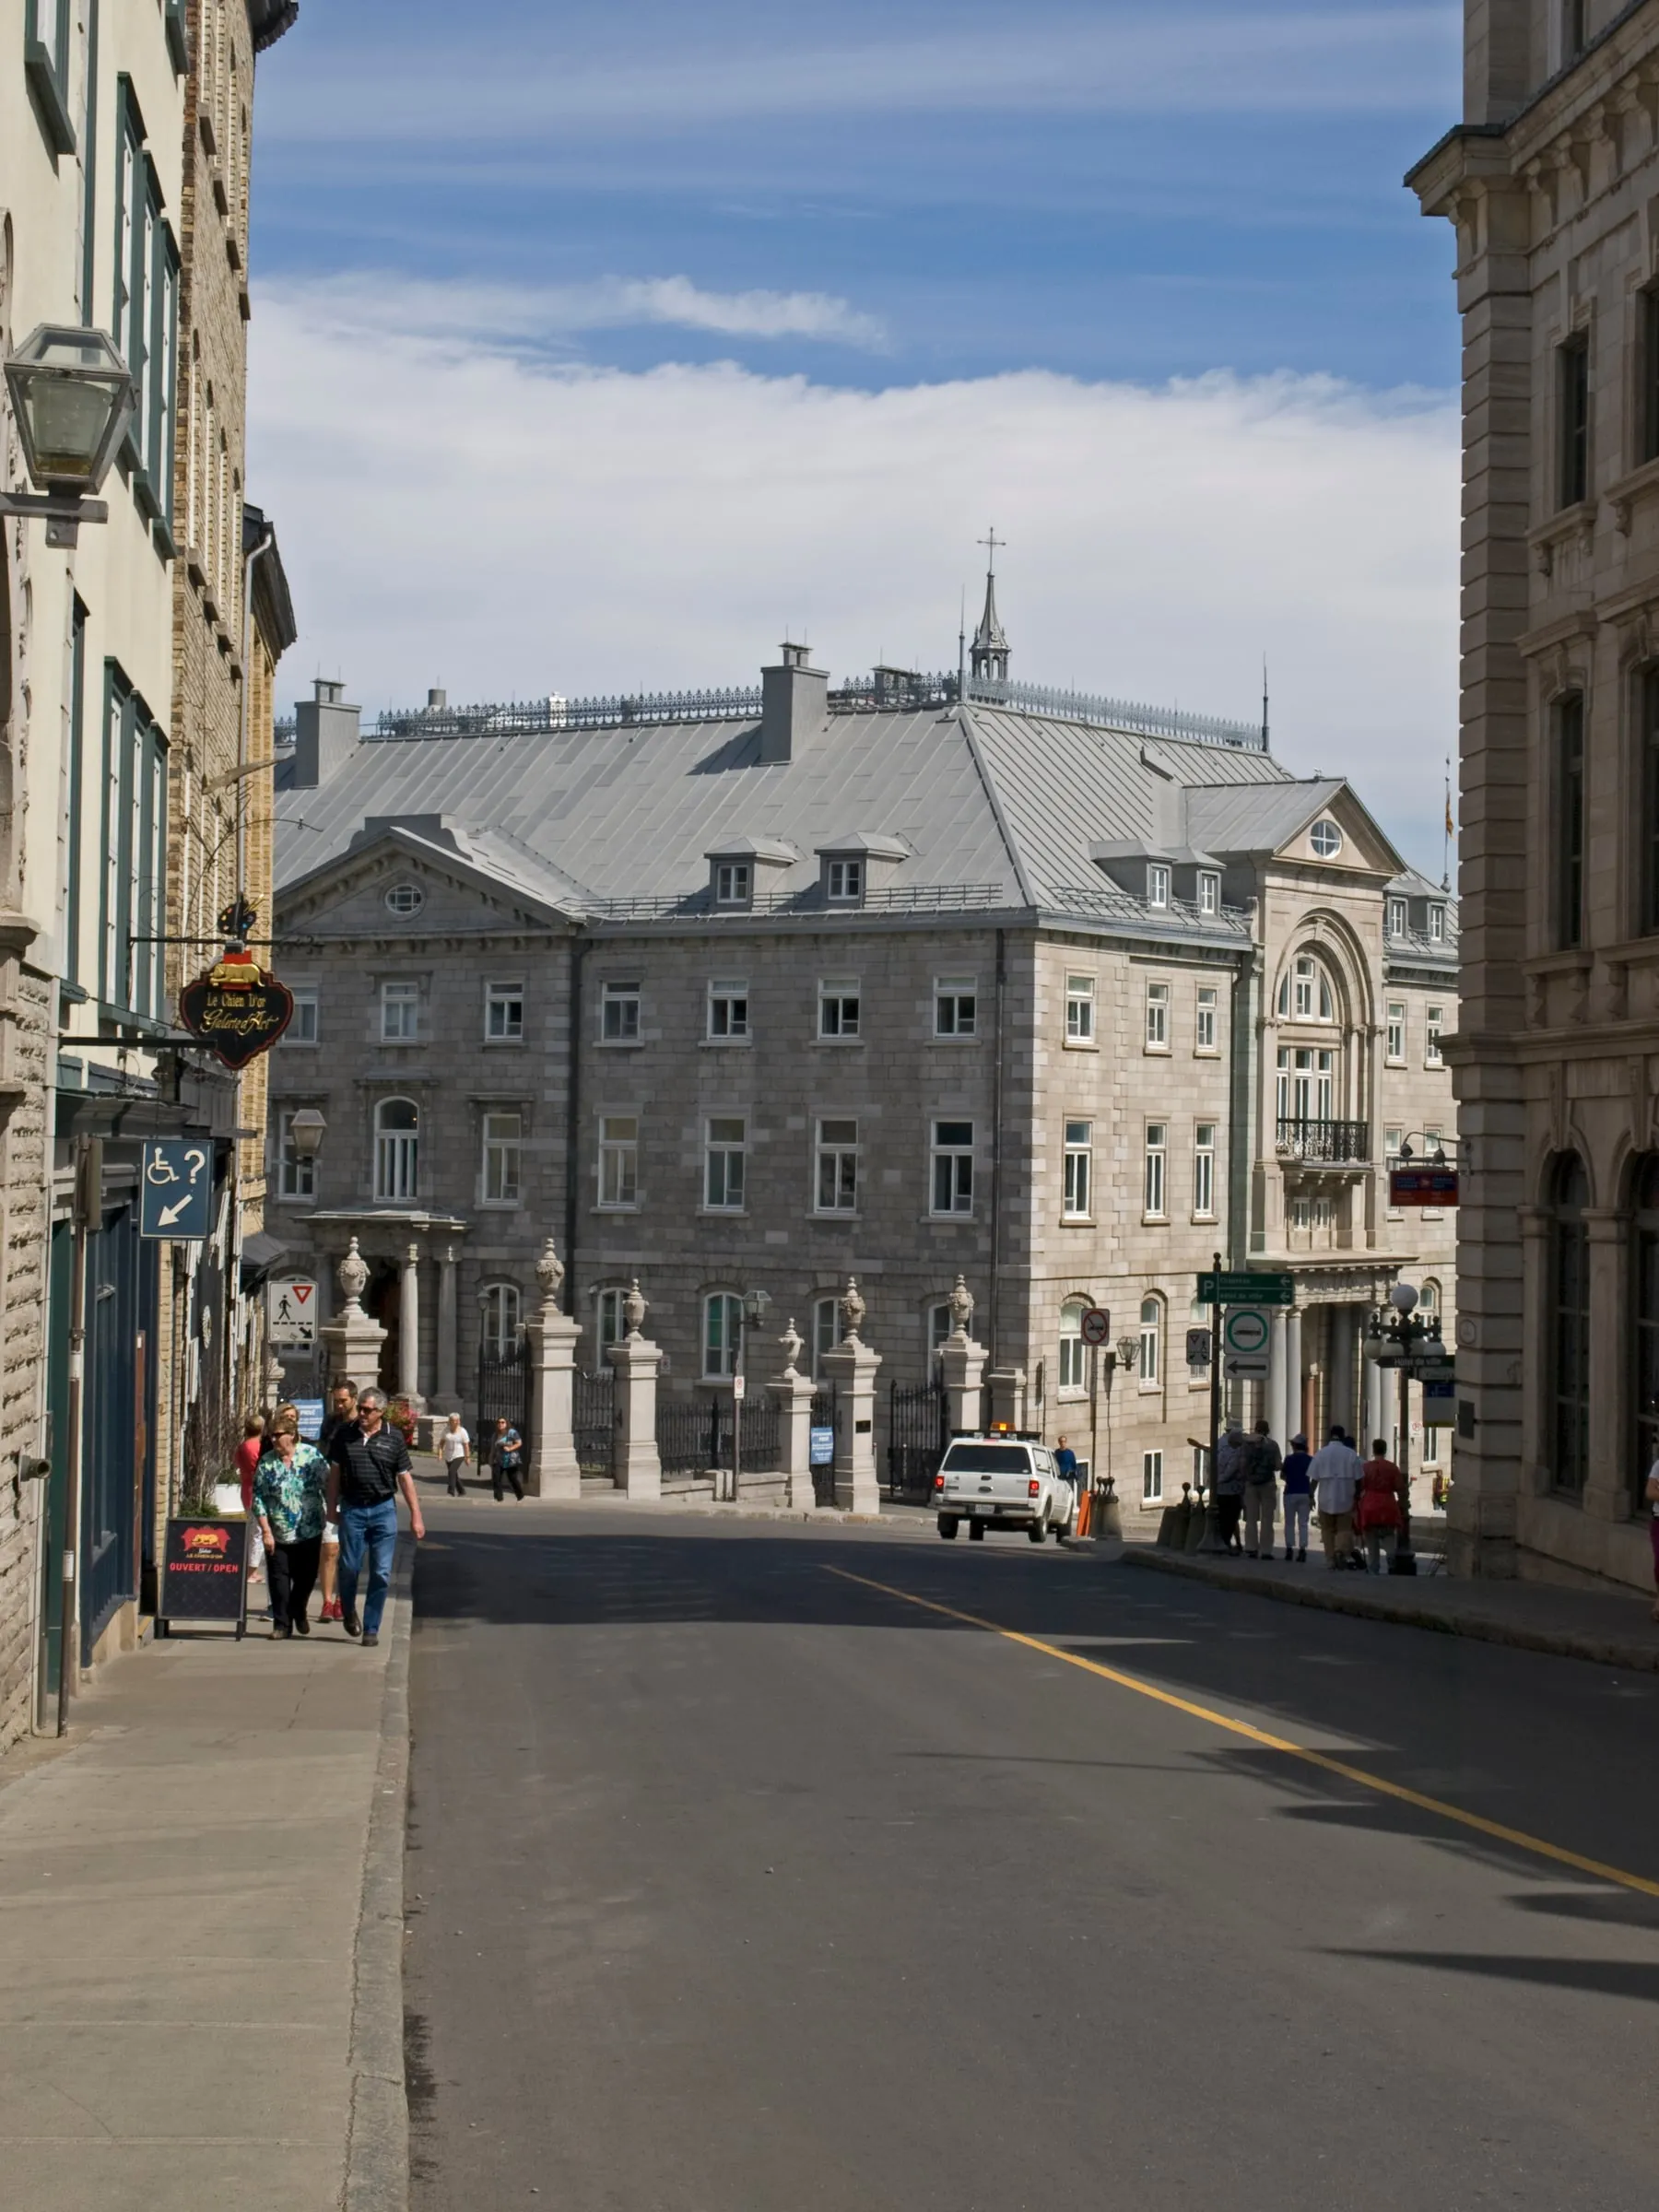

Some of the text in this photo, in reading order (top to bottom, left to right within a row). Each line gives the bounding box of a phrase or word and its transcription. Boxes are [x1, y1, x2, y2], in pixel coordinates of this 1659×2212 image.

[206, 992, 218, 1006] Le
[221, 992, 245, 1007] Chien
[170, 1562, 206, 1571] OUVERT
